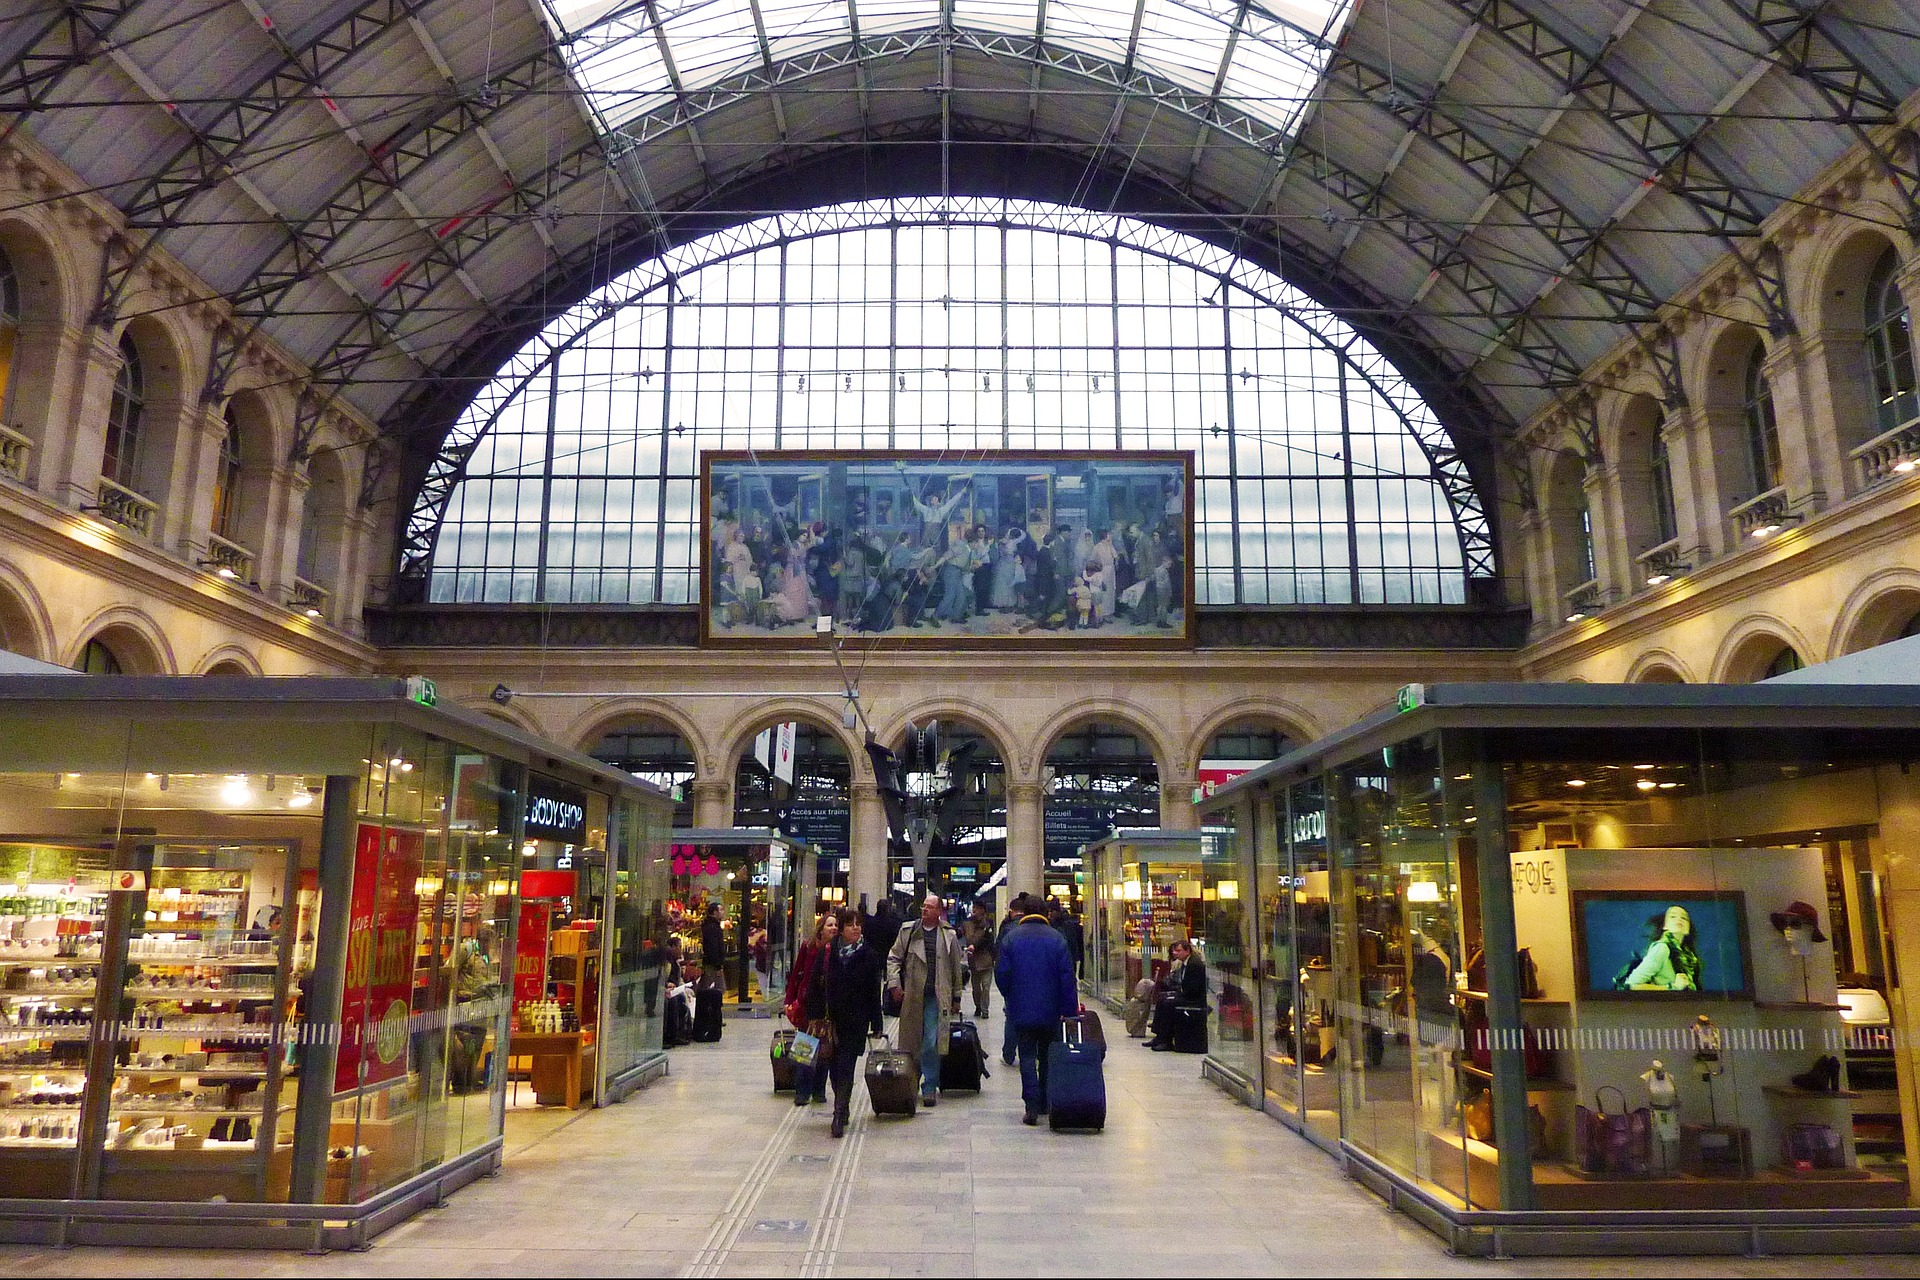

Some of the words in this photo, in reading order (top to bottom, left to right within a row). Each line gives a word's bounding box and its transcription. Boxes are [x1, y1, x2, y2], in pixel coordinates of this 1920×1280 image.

[531, 796, 559, 826] BODY
[559, 801, 583, 830] SHOP
[347, 928, 407, 989] SOLDES
